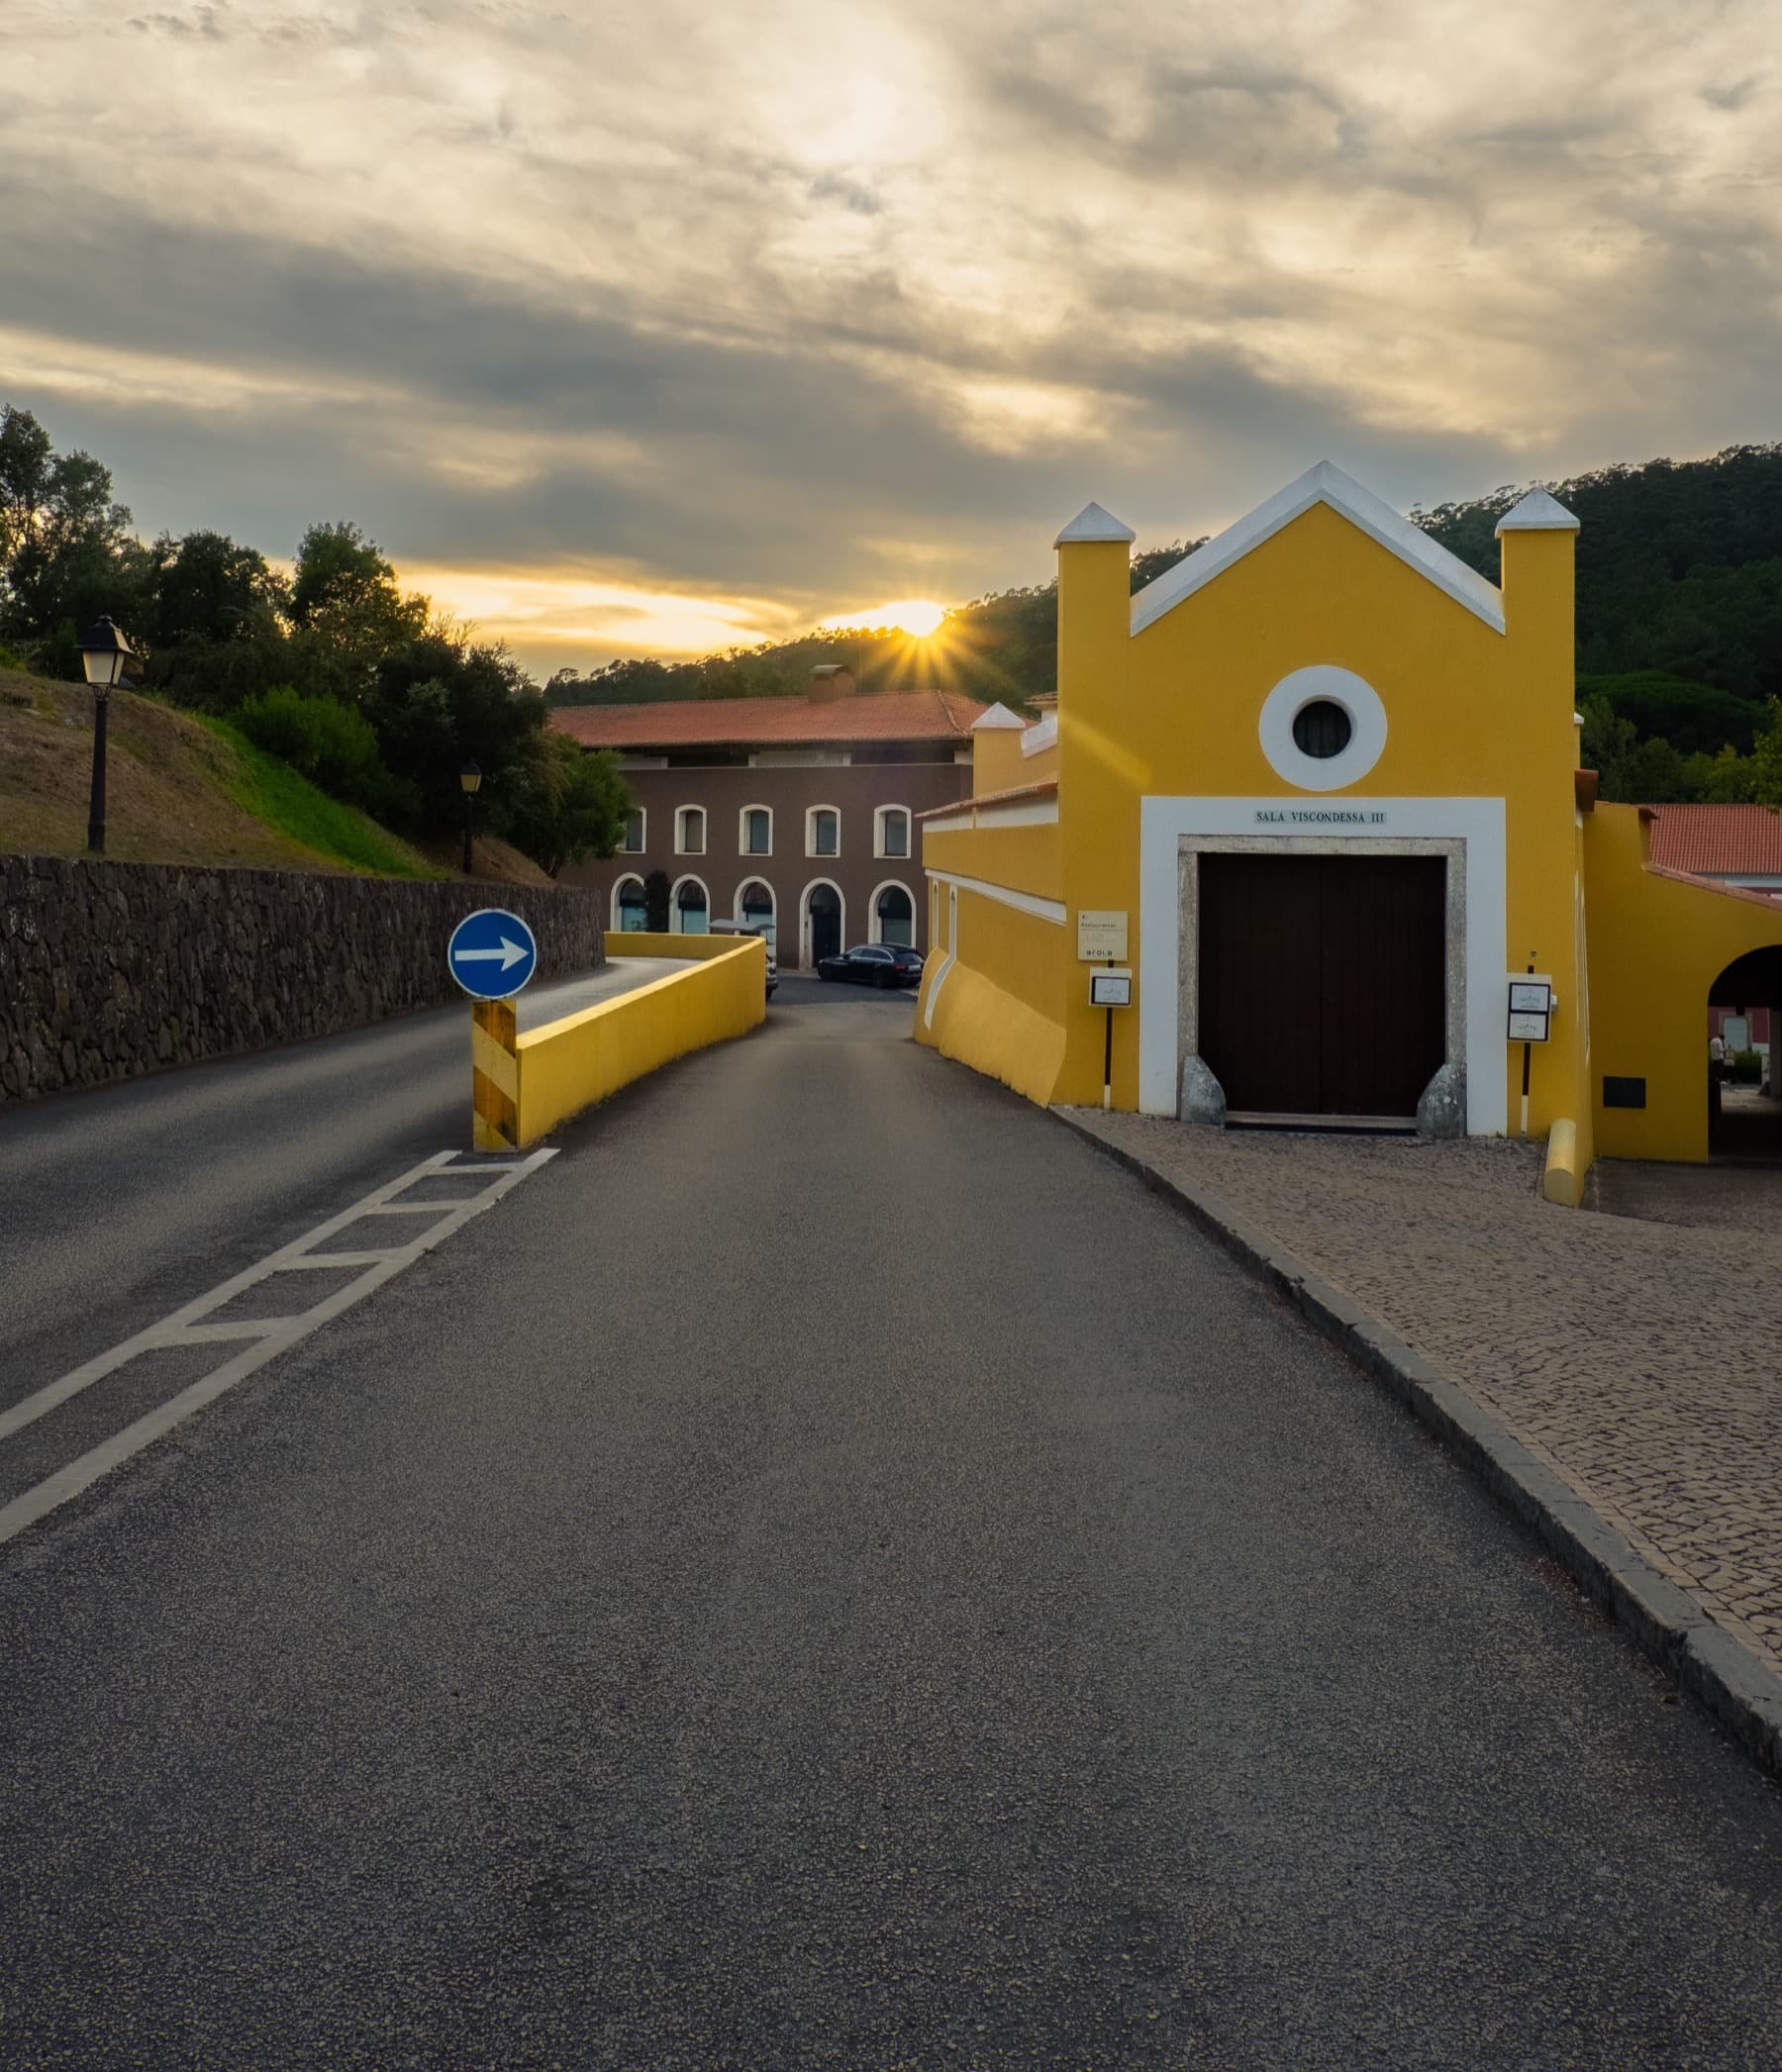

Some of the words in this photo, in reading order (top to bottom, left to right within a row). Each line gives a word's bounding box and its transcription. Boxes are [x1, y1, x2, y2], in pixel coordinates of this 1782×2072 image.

[1256, 812, 1285, 822] SALA
[1291, 812, 1365, 823] VISCONDESSA
[1371, 812, 1384, 823] III
